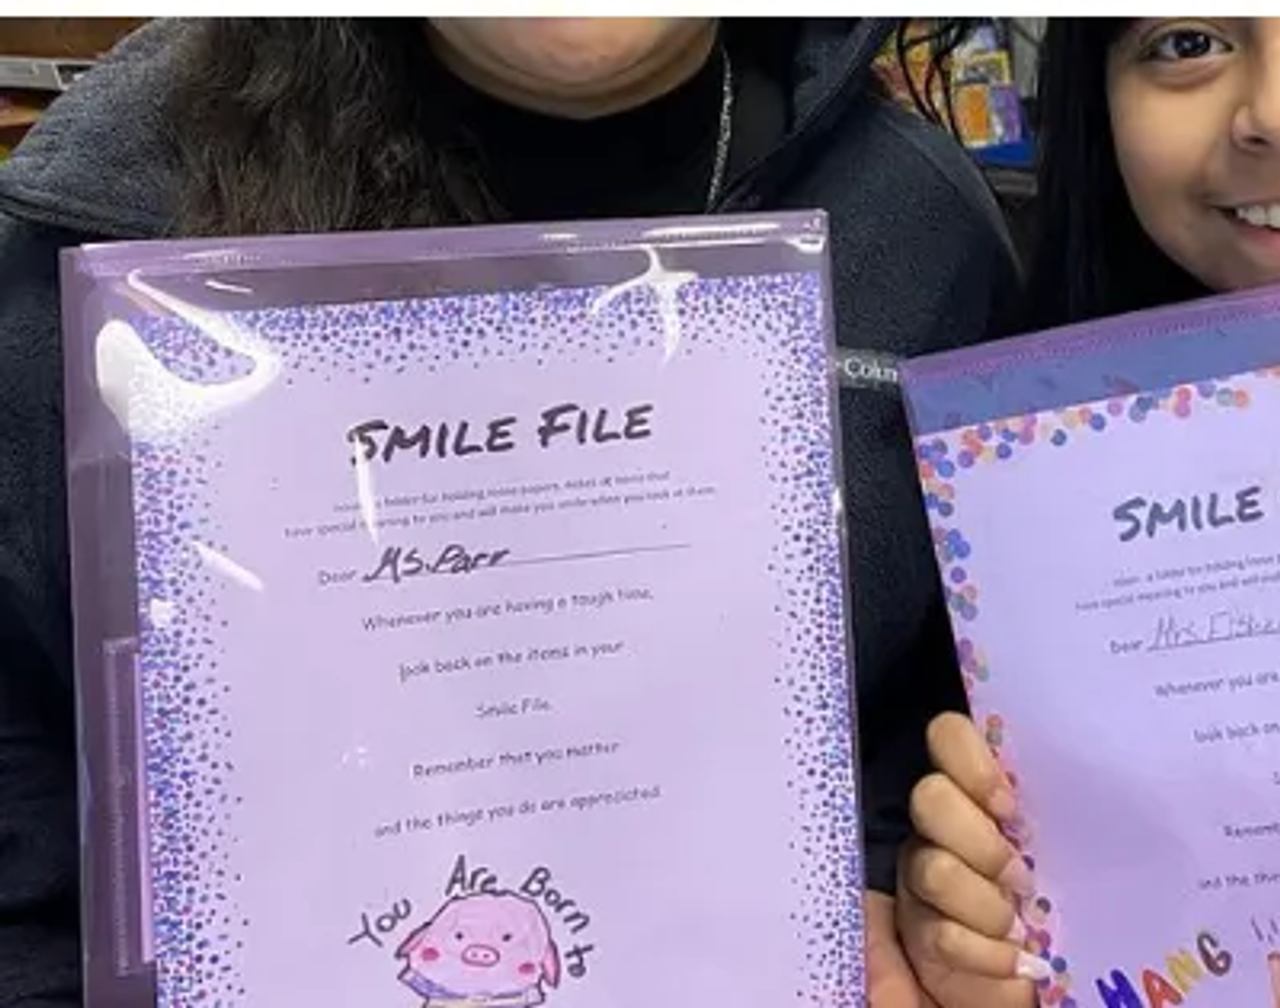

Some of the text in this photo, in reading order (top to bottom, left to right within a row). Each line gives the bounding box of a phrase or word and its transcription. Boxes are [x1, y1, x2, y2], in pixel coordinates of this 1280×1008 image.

[347, 402, 654, 467] SMILE FILE
[1112, 485, 1264, 543] SMILE
[348, 853, 596, 979] You Are Born to
